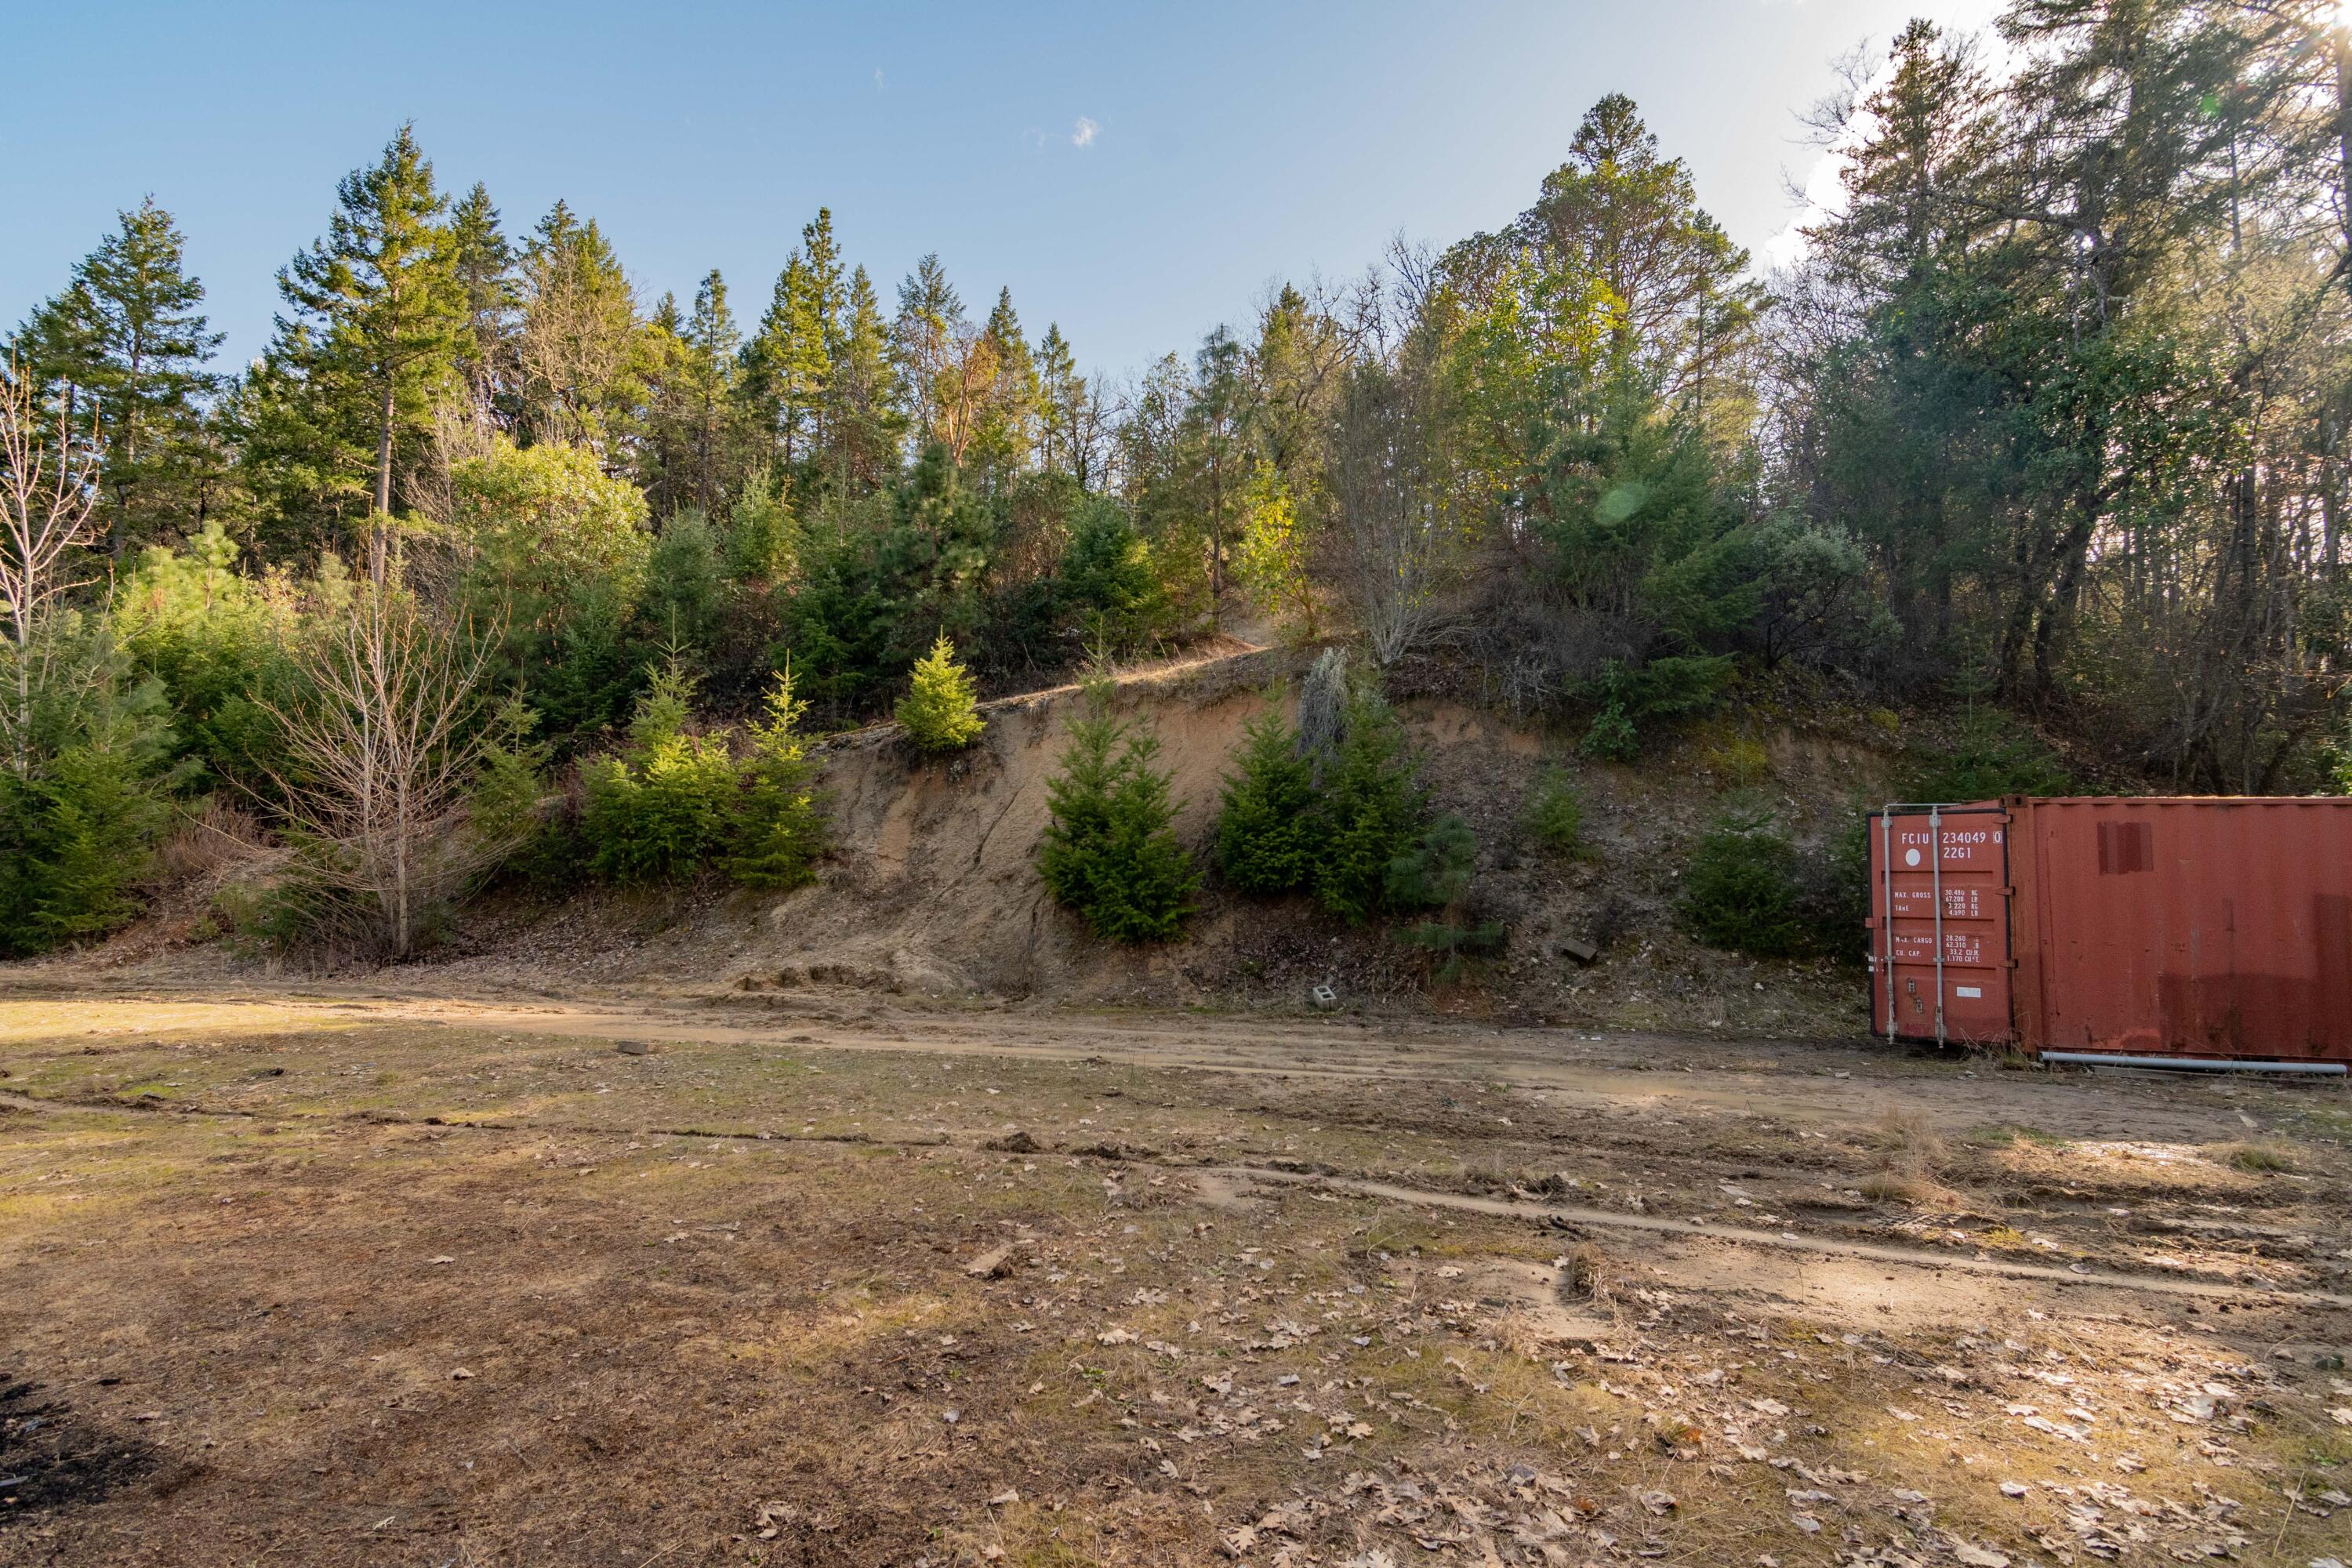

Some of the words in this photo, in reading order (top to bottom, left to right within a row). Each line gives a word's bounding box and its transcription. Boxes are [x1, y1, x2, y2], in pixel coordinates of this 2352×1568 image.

[1901, 833, 1929, 844] FCIU
[1943, 832, 1986, 844] 234049
[1994, 832, 2001, 844] 0
[1944, 847, 1971, 858] 22G1
